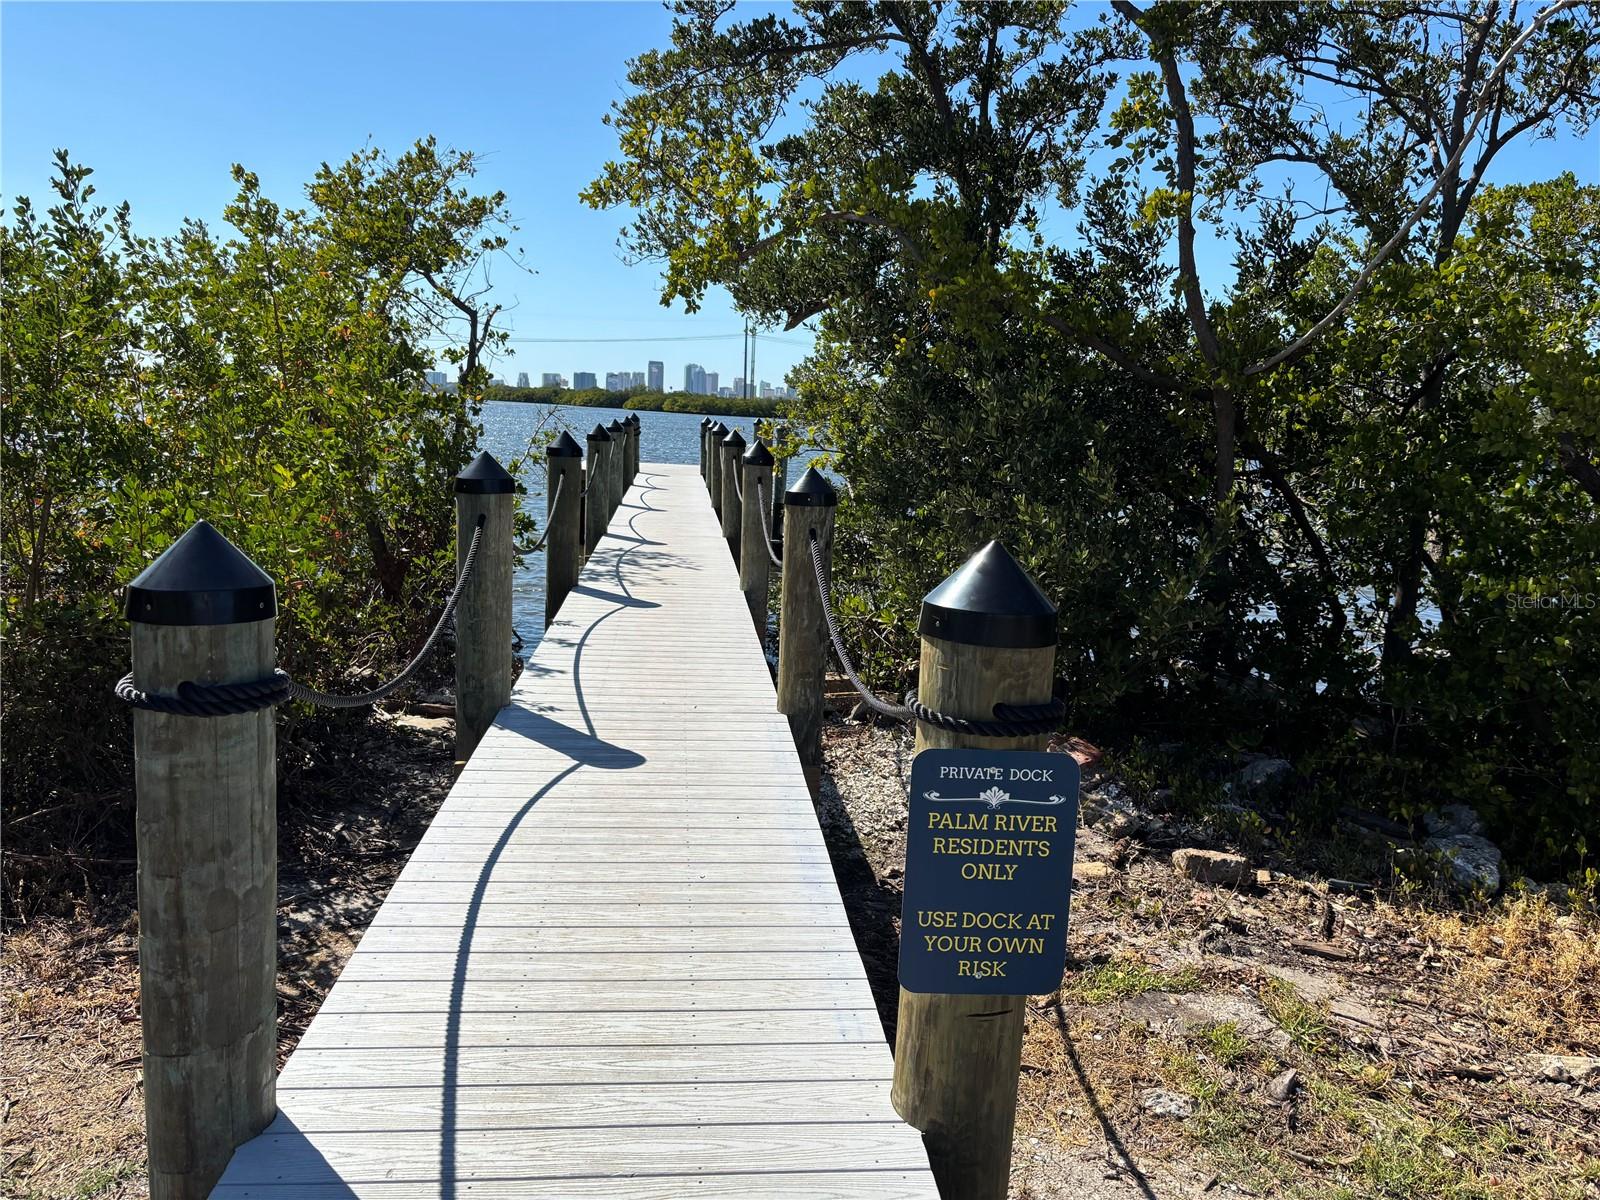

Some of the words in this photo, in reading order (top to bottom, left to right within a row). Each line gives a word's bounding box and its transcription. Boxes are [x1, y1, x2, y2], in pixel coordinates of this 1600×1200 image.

[939, 766, 1004, 780] PRIVATE
[1009, 768, 1053, 782] DOCK
[927, 812, 989, 831] PALM
[994, 814, 1057, 833] RIVER
[932, 837, 1051, 857] RESIDENTS
[961, 862, 1019, 881] ONLY
[917, 910, 958, 928] USE
[961, 911, 1023, 930] DOCK
[1025, 913, 1055, 931] AT
[923, 935, 982, 953] YOUR
[986, 936, 1045, 954] OWN
[957, 960, 1008, 978] RISK
